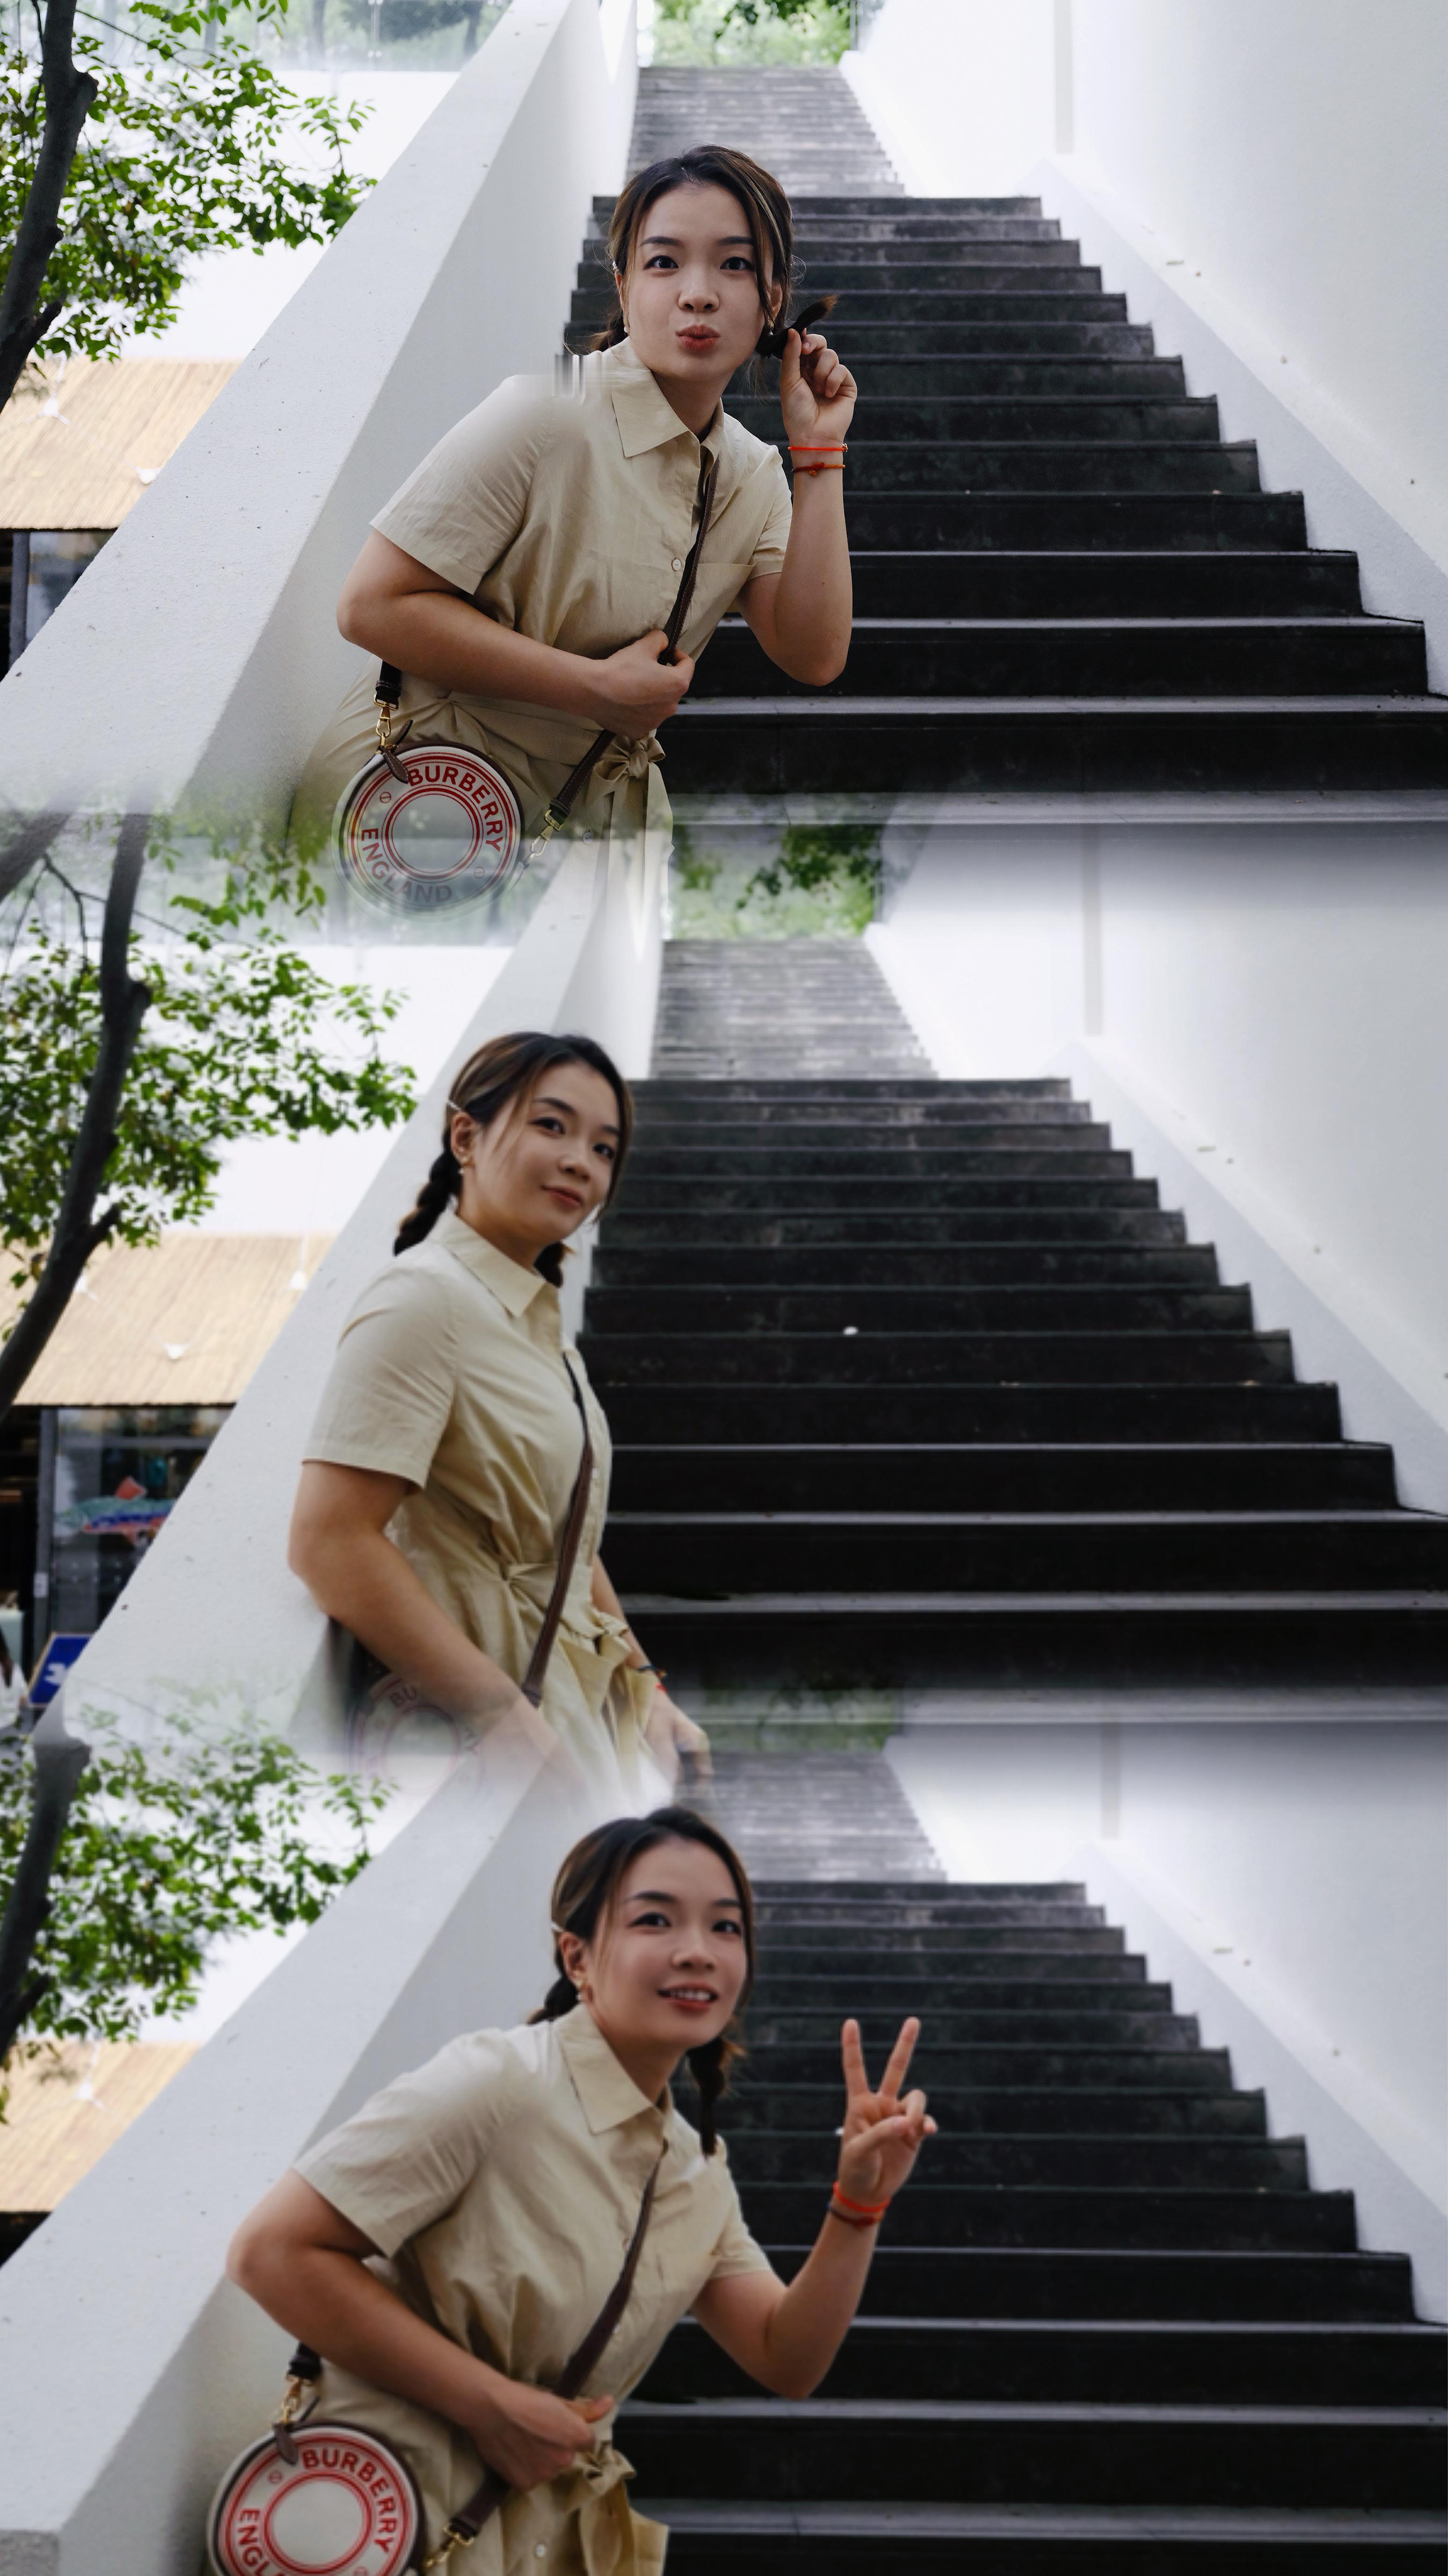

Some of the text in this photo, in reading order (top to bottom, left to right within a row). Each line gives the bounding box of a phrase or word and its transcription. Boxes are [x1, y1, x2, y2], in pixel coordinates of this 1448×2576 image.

[408, 765, 504, 852] BURBERRY
[361, 828, 453, 903] ENGLAND
[301, 2448, 399, 2554] BURBERRY
[237, 2508, 285, 2576] ENGL
